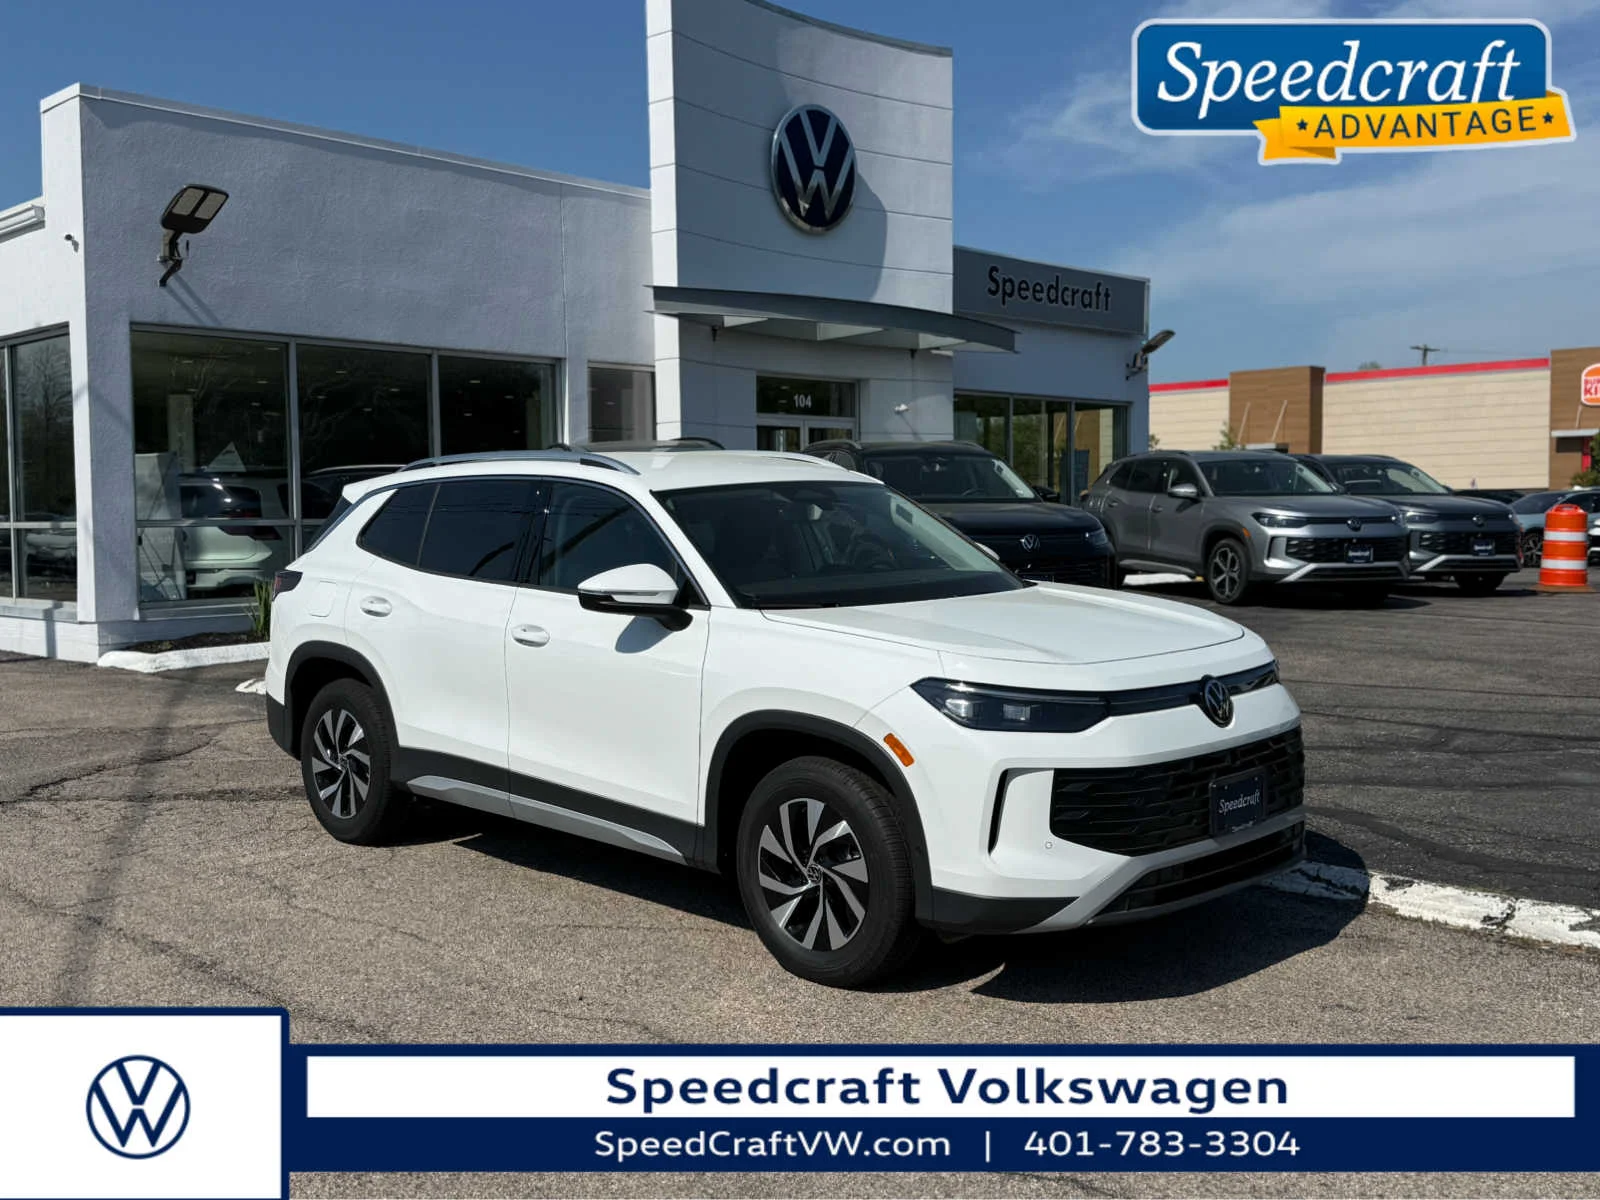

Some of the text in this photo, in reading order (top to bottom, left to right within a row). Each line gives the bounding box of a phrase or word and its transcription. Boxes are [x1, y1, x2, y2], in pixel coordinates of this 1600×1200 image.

[987, 265, 1111, 312] Speedcraft
[793, 393, 812, 409] 104
[1219, 789, 1260, 815] Speedcraft
